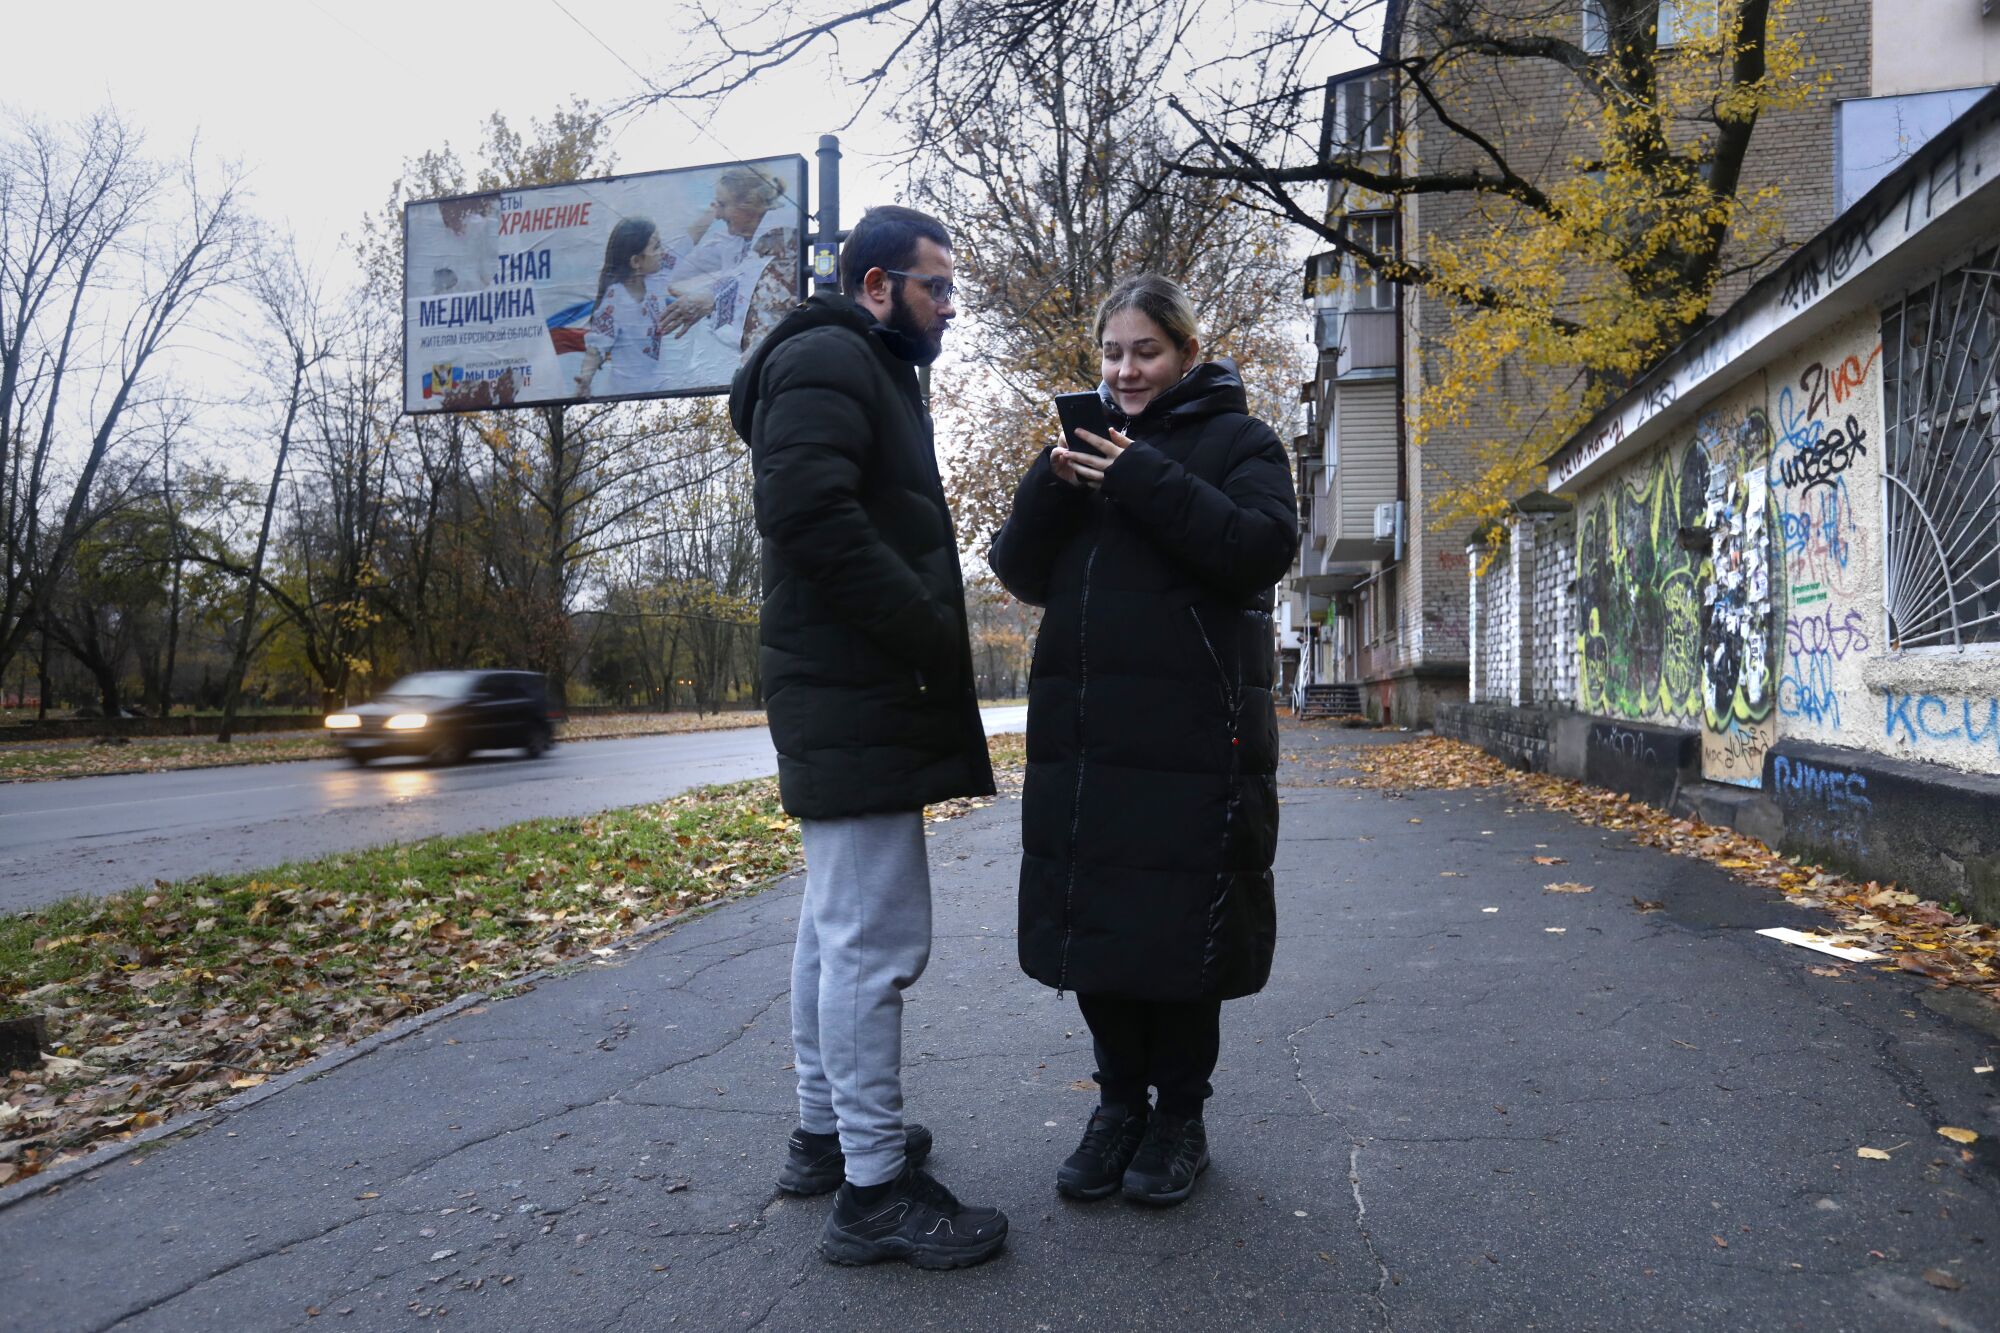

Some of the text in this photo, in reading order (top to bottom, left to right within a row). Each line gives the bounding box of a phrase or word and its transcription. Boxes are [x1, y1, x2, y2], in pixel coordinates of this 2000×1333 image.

[498, 202, 592, 236] ХРАНЕНИЕ
[420, 288, 535, 327] МЕДИЦИНА
[420, 326, 543, 348] ЖИТЕЛЯМ ХЕРСОНСКОЙ ОБЛАСТИ
[465, 365, 532, 381] МЫ ВМТЕ
